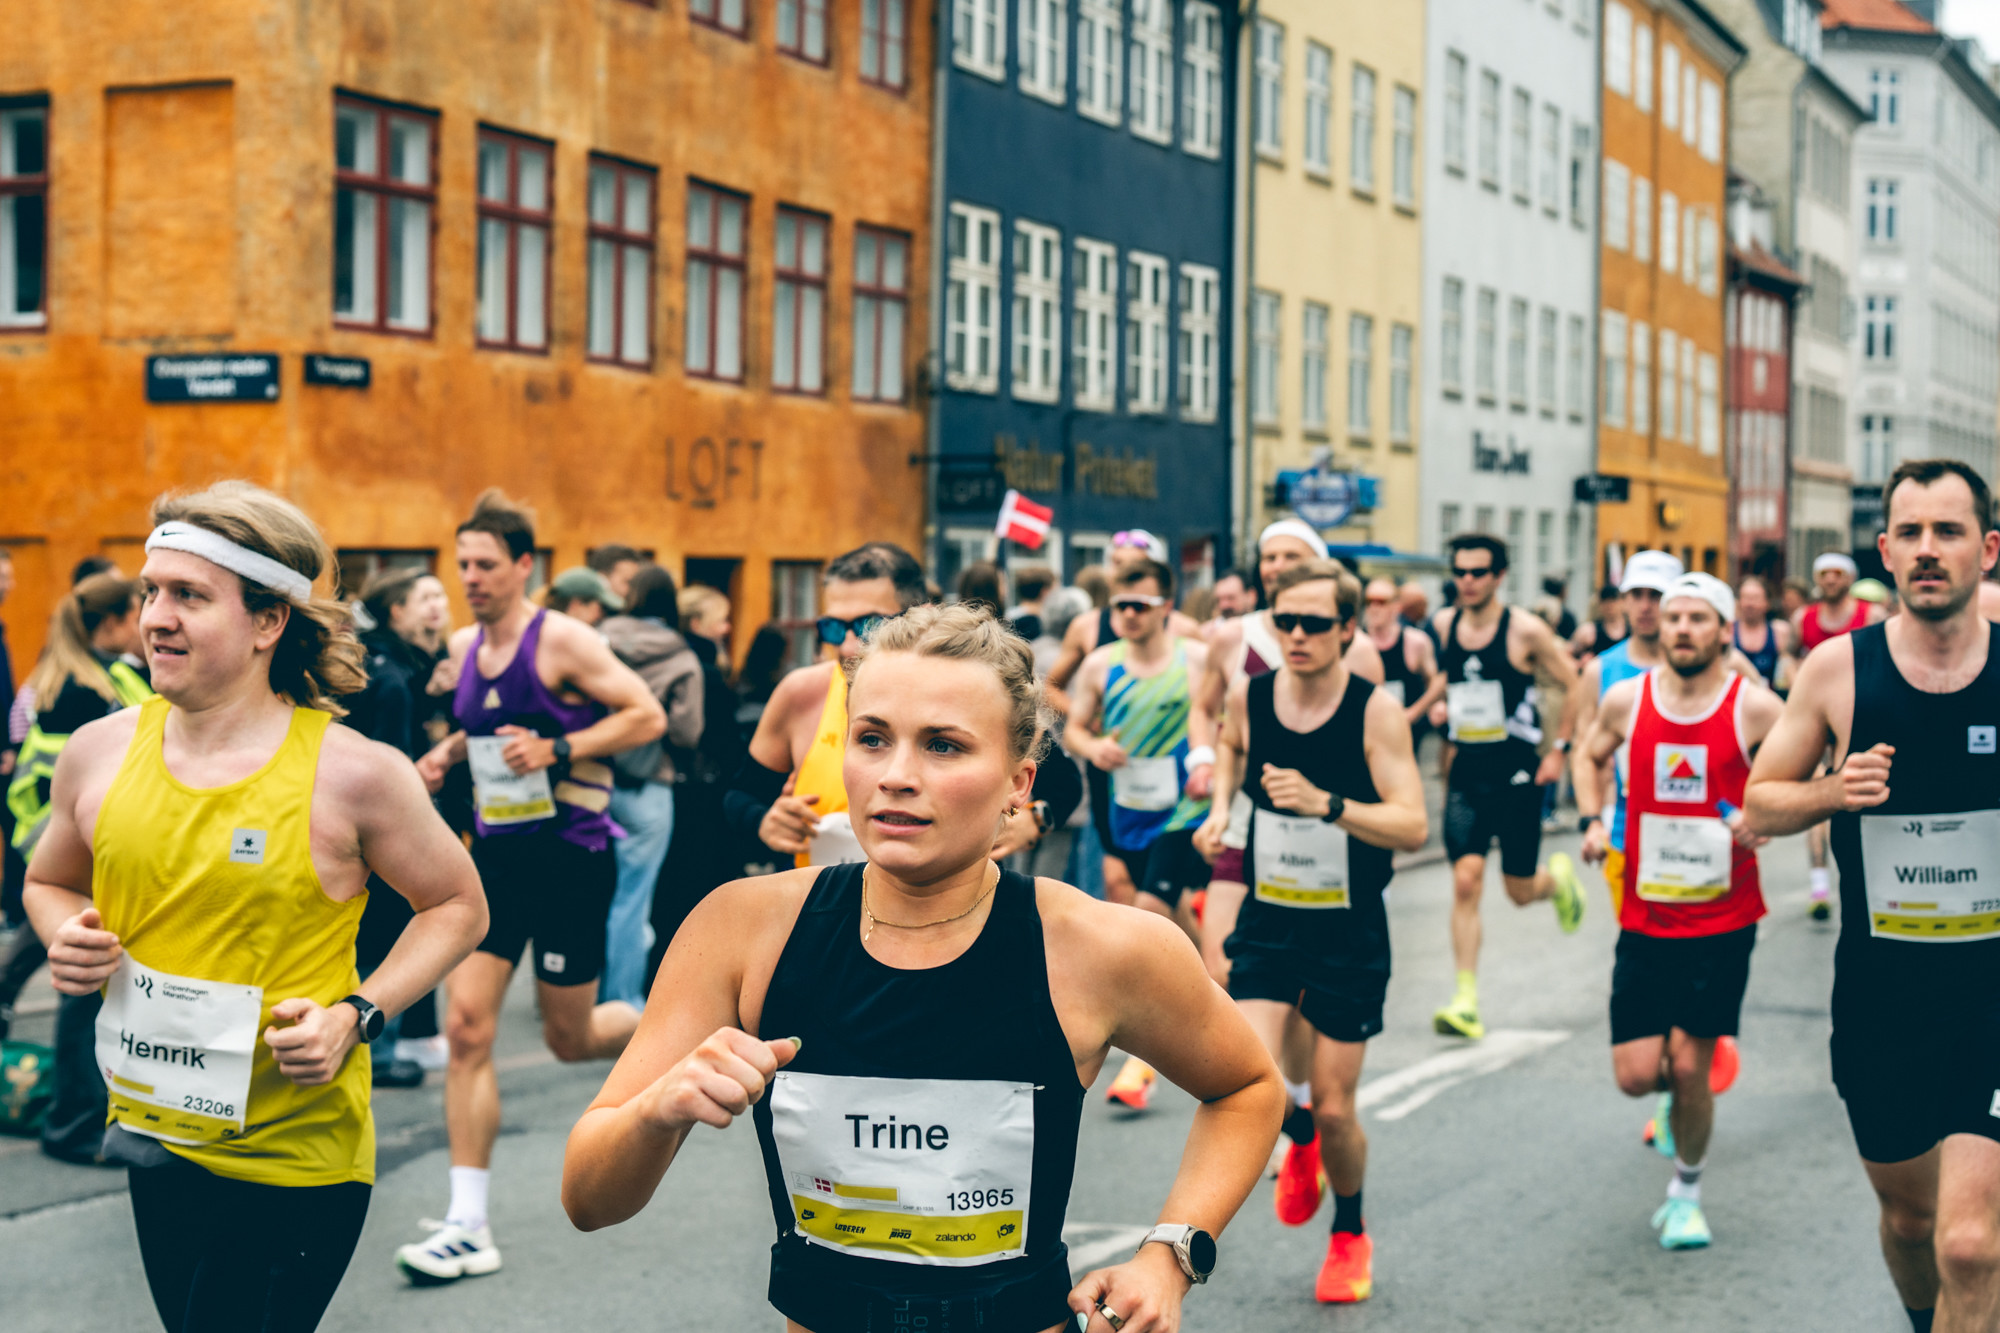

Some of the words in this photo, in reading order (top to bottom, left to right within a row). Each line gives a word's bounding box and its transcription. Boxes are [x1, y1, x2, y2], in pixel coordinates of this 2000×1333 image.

[664, 436, 765, 509] LOFT
[1894, 865, 1978, 884] William
[163, 982, 209, 997] Copenhagen
[120, 1028, 205, 1070] Henrik
[183, 1095, 235, 1117] 23206
[845, 1114, 949, 1150] Trine
[946, 1188, 1014, 1211] 13965
[935, 1233, 977, 1242] zalando
